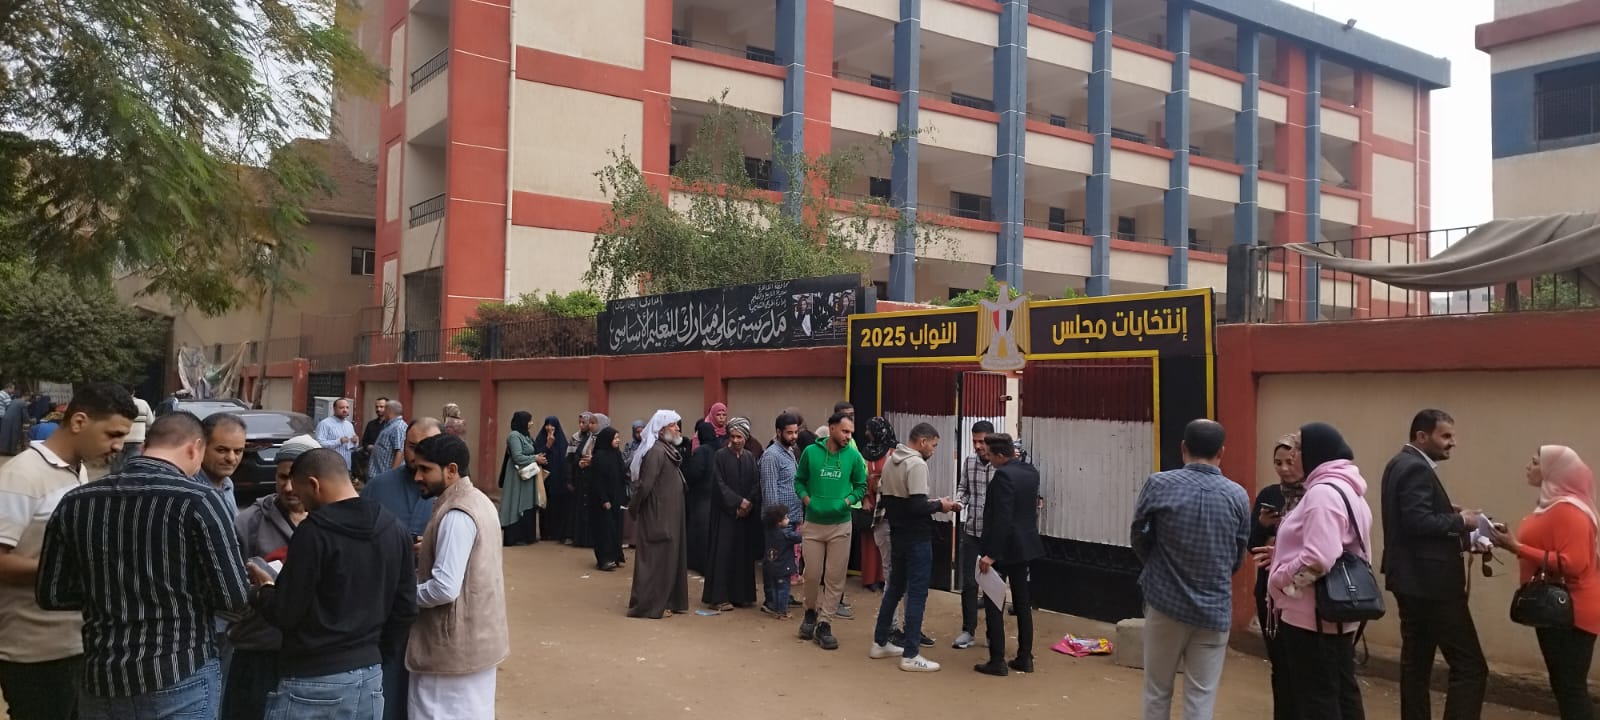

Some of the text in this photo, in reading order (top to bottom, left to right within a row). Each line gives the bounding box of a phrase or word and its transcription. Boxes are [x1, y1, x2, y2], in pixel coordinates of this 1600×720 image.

[860, 306, 1187, 350] إنتخابات مجلس النواب 2025
[914, 660, 928, 669] FILA
